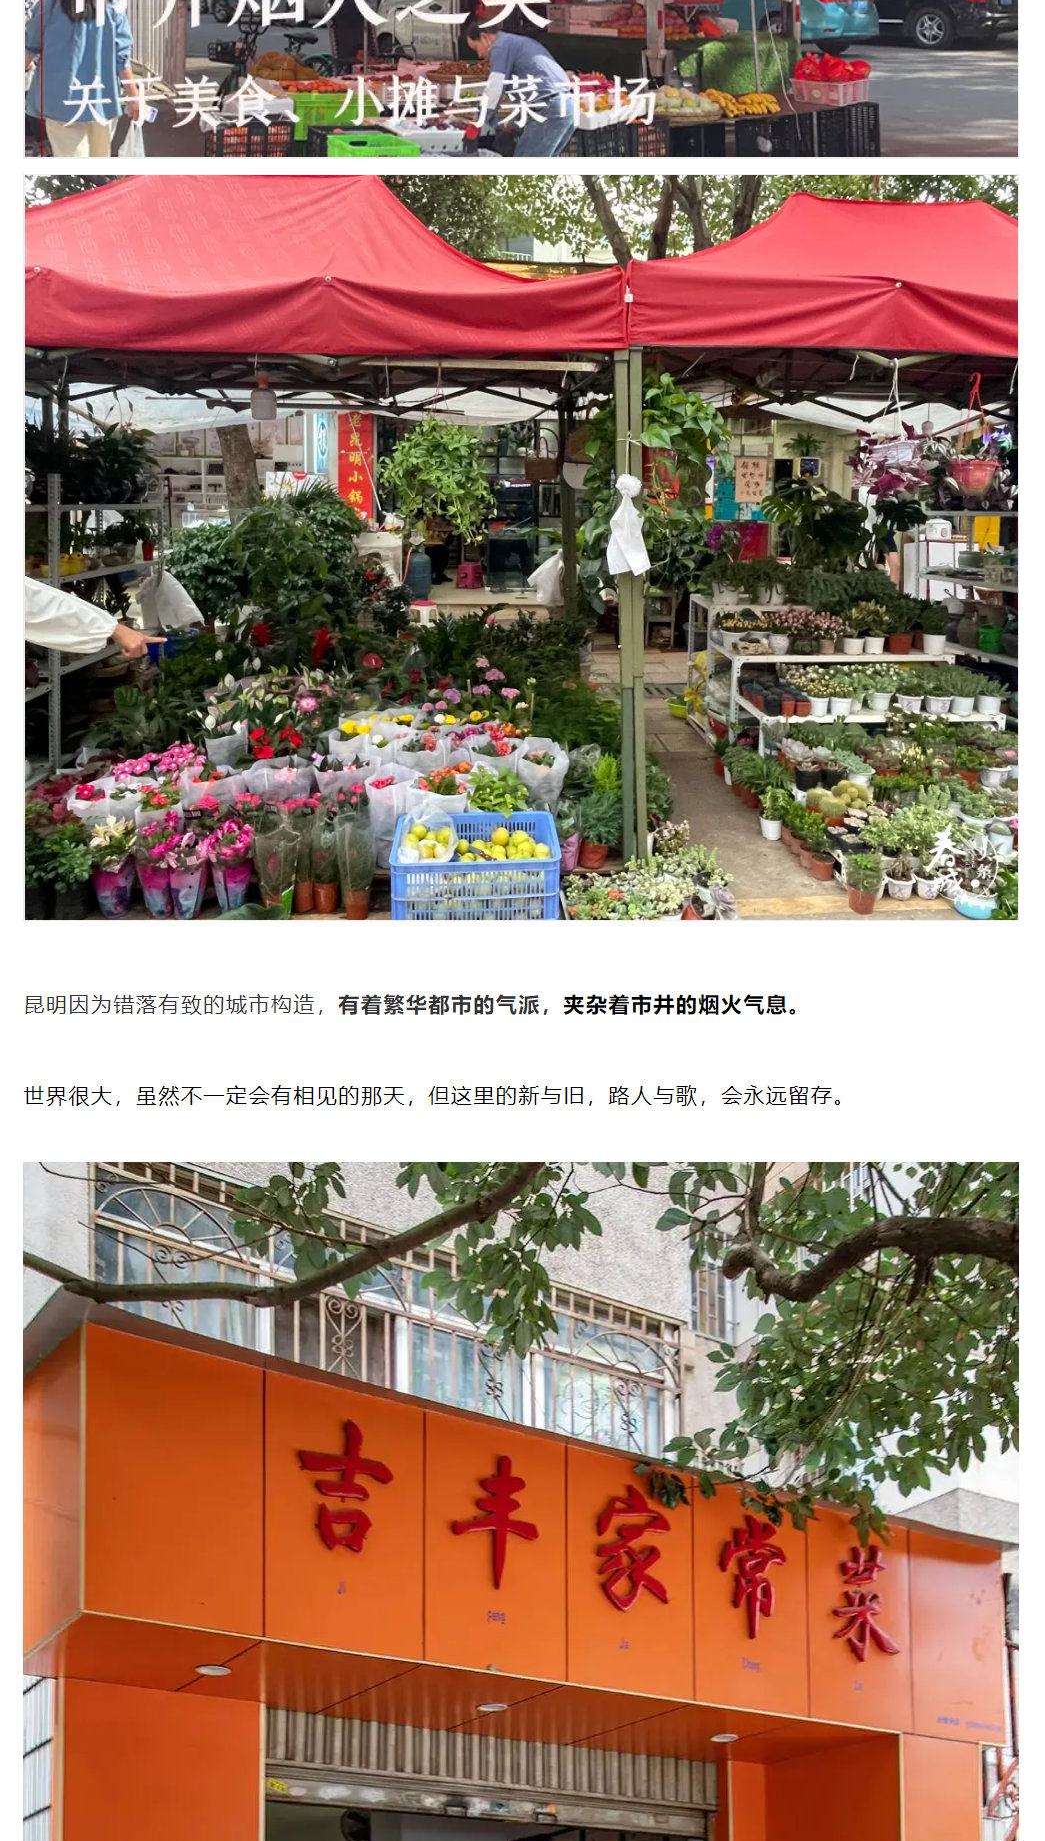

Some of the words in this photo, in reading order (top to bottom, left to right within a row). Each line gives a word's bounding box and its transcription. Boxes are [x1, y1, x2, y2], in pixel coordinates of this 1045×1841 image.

[24, 993, 798, 1016] 昆明因为错落有致的城市构造，有着繁华都市的气派，夹杂着市井的烟火气息。
[24, 1084, 843, 1107] 世界很大，虽然不一定会有相见的那天，但这里的新与旧，路人与歌，会永远留存。
[299, 1418, 900, 1661] 吉丰家常菜
